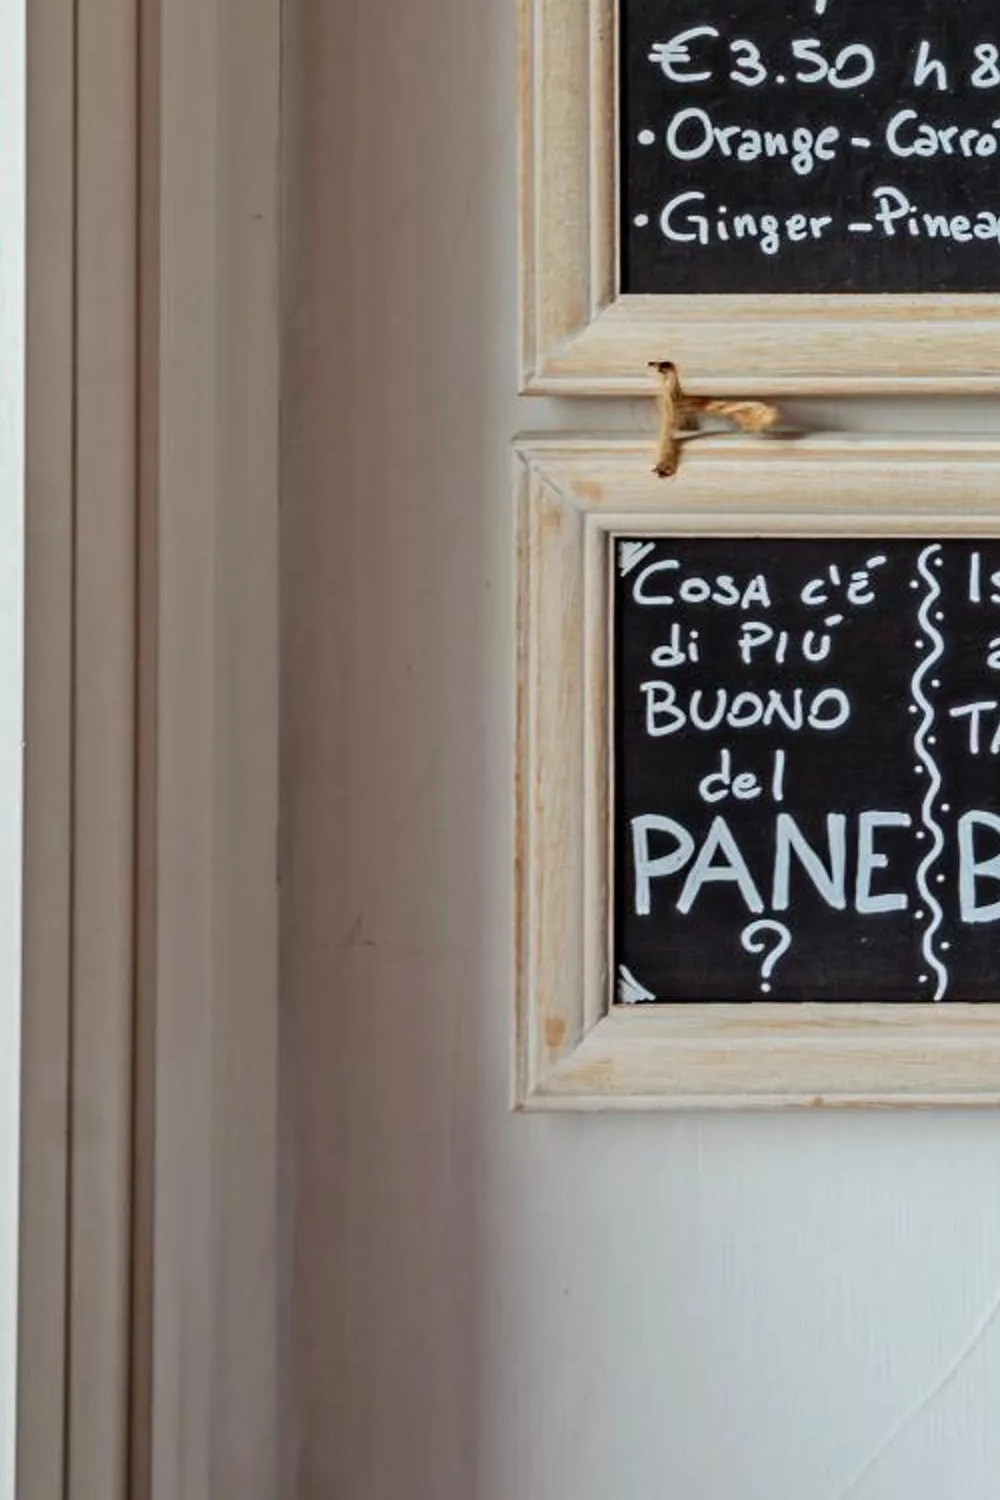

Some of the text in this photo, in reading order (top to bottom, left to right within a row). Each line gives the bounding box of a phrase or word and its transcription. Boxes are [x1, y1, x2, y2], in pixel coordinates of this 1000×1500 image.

[729, 38, 875, 89] 3.50
[913, 40, 948, 91] h
[659, 191, 833, 255] Ginger
[651, 623, 699, 667] di
[639, 680, 850, 737] BUONO
[698, 748, 785, 803] del
[630, 810, 912, 916] PANE
[740, 919, 792, 993] ?
